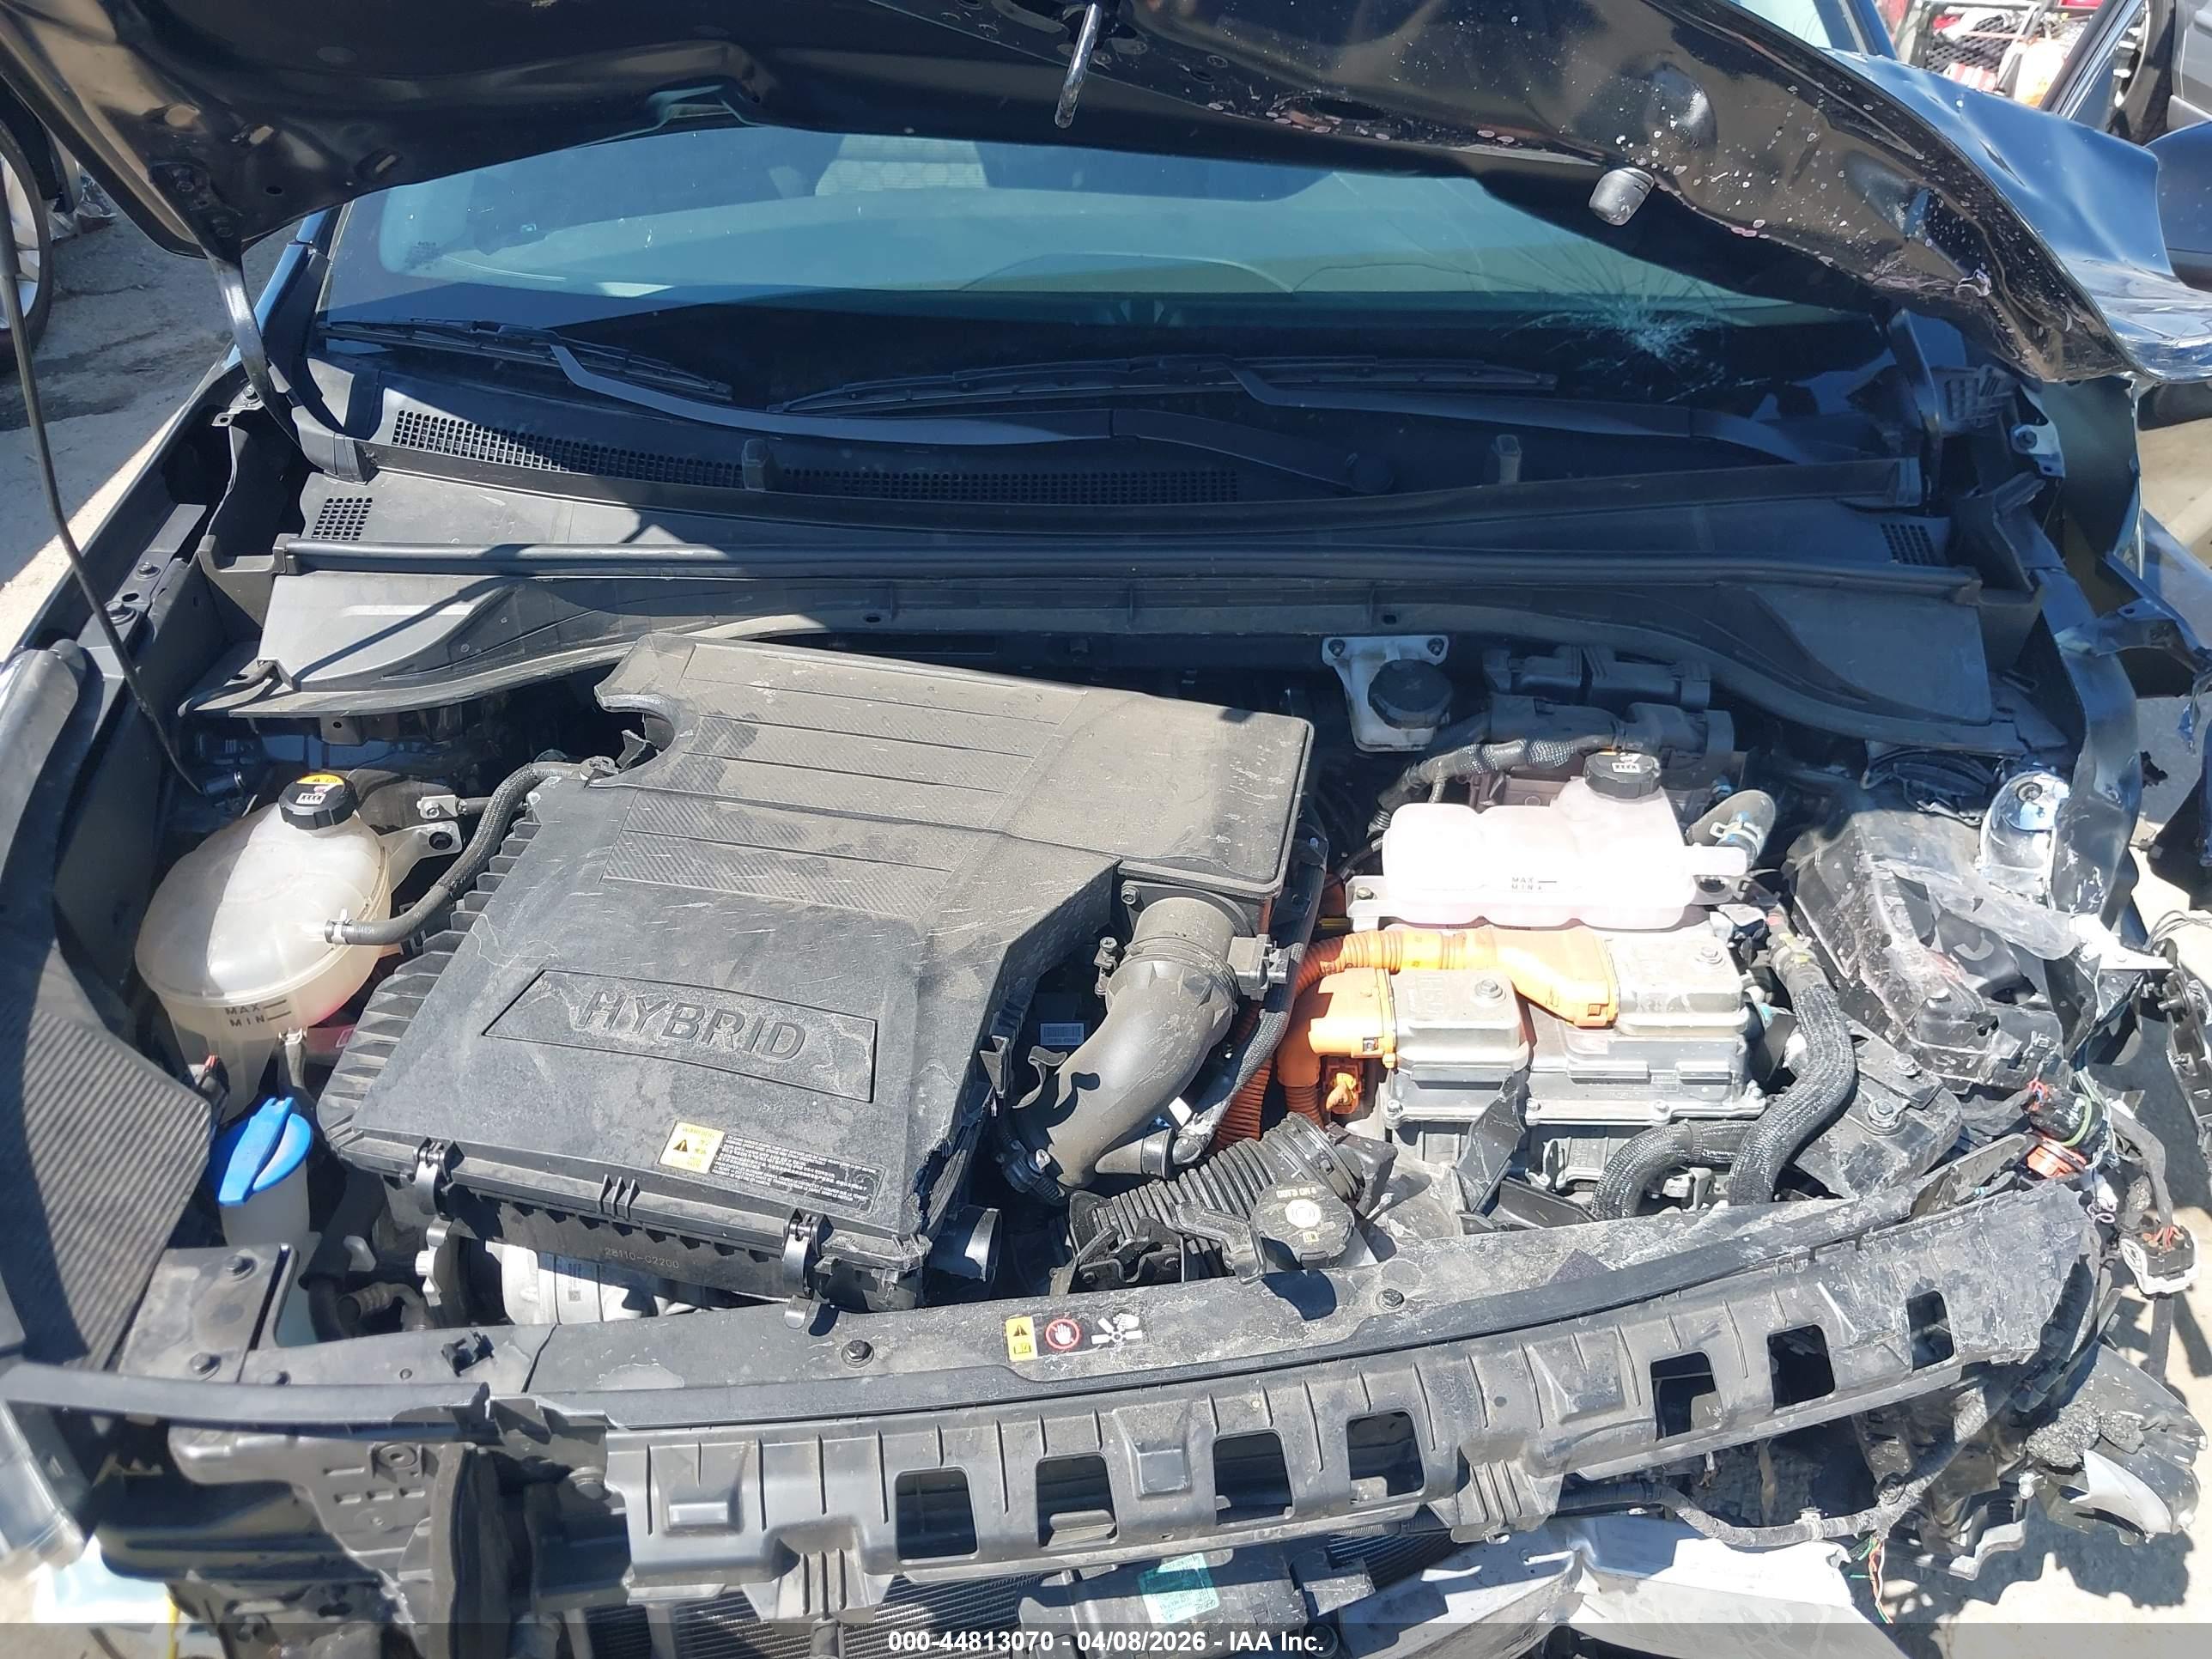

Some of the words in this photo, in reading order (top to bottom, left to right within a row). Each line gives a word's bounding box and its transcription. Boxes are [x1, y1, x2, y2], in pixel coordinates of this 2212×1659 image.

[224, 1002, 260, 1015] MAX
[229, 1014, 265, 1027] MIN
[576, 990, 806, 1060] HYBRID
